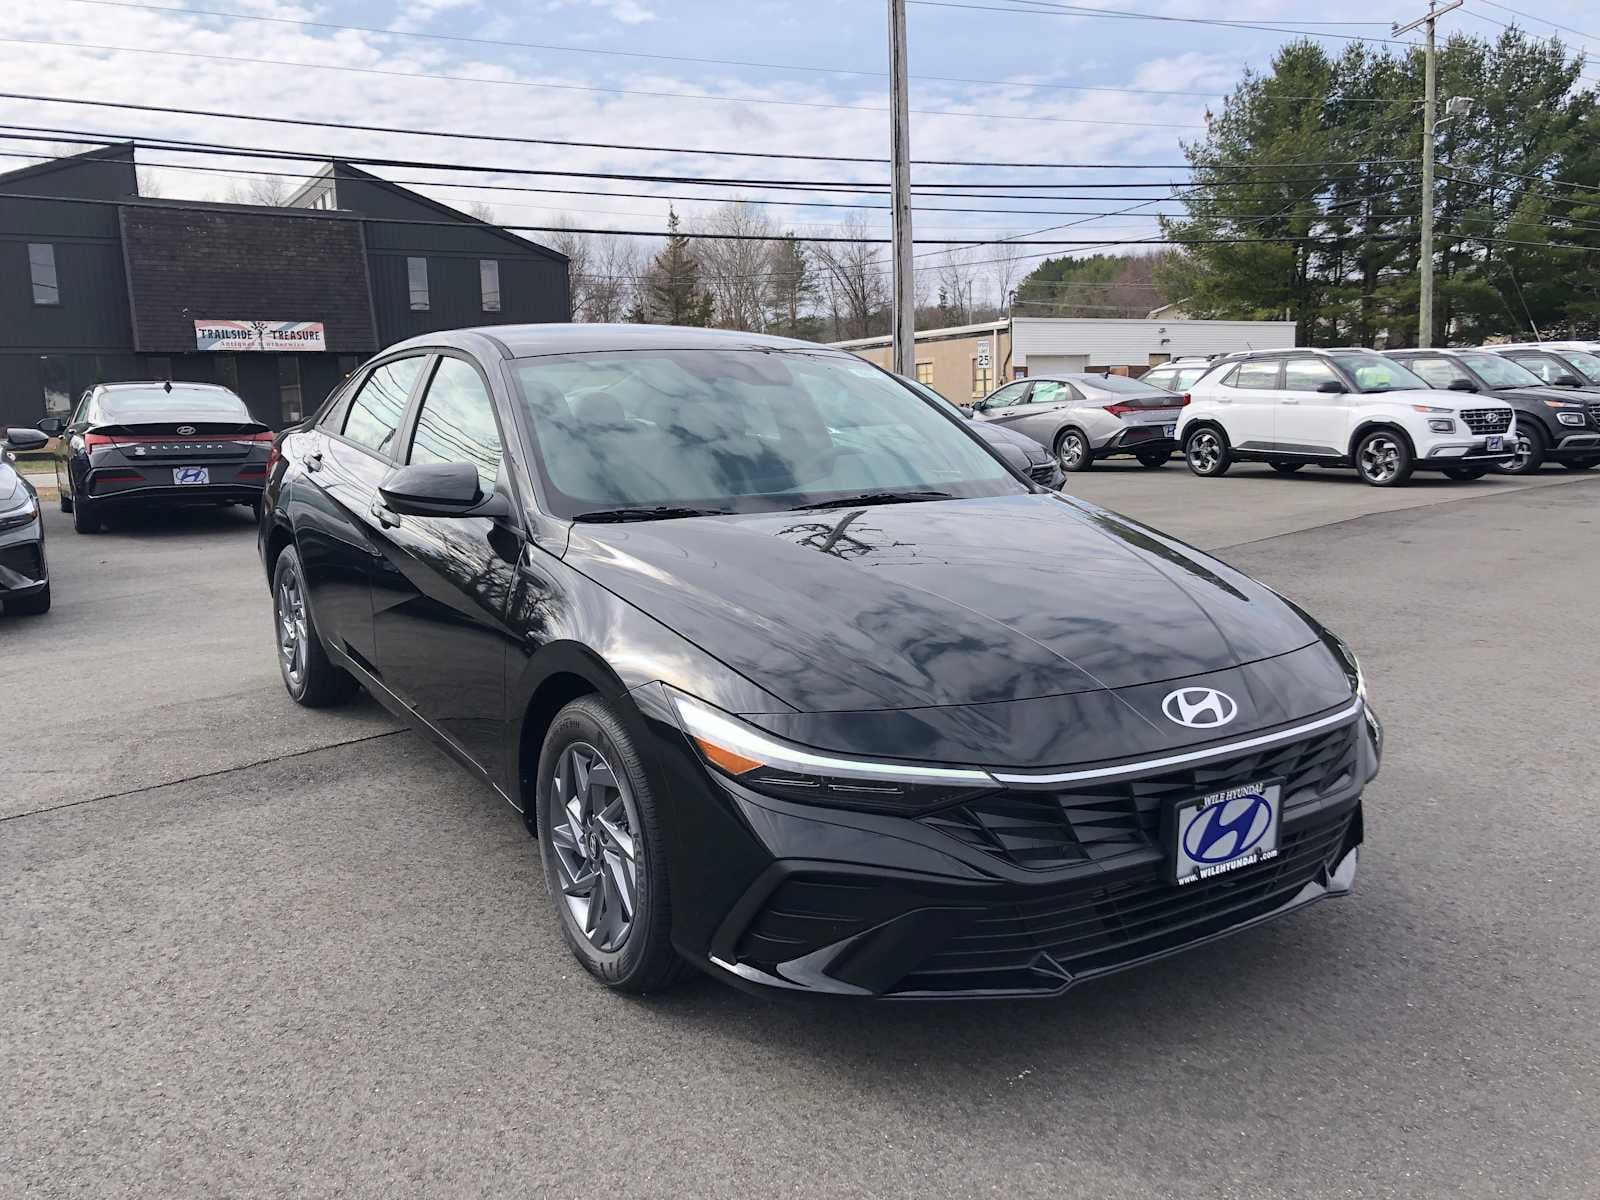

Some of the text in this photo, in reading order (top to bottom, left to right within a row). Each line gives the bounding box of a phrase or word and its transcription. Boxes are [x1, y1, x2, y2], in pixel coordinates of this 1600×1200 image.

[199, 328, 320, 340] TRAILSIDE TREASURE
[978, 355, 989, 366] 25
[1226, 782, 1264, 801] HYUNDAI
